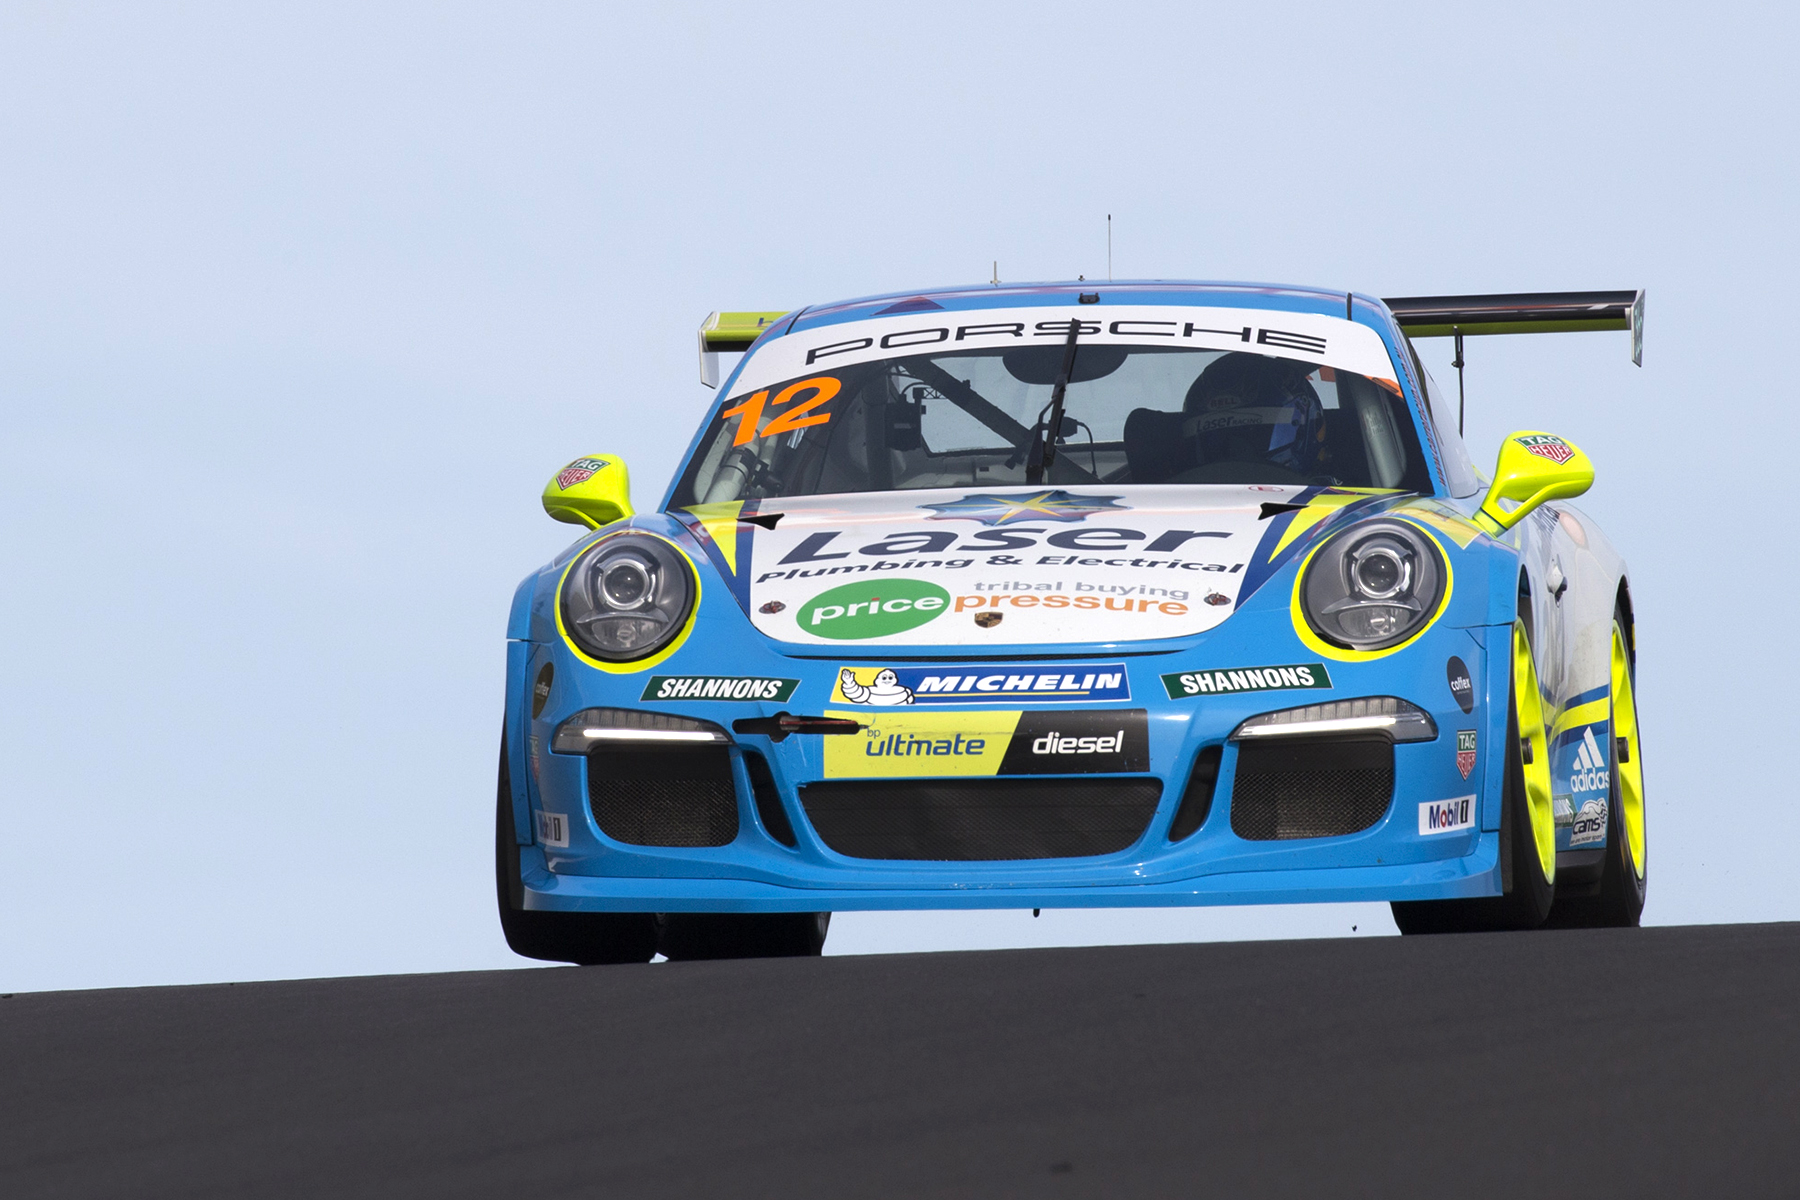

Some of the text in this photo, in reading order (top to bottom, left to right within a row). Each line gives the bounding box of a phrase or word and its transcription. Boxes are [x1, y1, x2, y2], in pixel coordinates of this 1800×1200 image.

[805, 320, 1327, 366] PORSCHE
[722, 376, 842, 447] 12
[776, 527, 1234, 566] Laser
[755, 554, 1245, 583] Plumbing & Electrical
[974, 580, 1190, 600] tribal buying
[811, 596, 945, 626] price
[954, 593, 1189, 616] pressure
[656, 678, 783, 699] SHANNONS
[915, 672, 1122, 693] MICHELIN
[1179, 666, 1315, 695] SHANNONS
[865, 733, 986, 756] ultimate
[866, 728, 881, 739] bp
[1032, 730, 1125, 755] diesel
[1458, 734, 1476, 750] TAG
[1570, 767, 1610, 793] adidas
[1428, 801, 1460, 829] Mobil
[1572, 817, 1601, 836] cams
